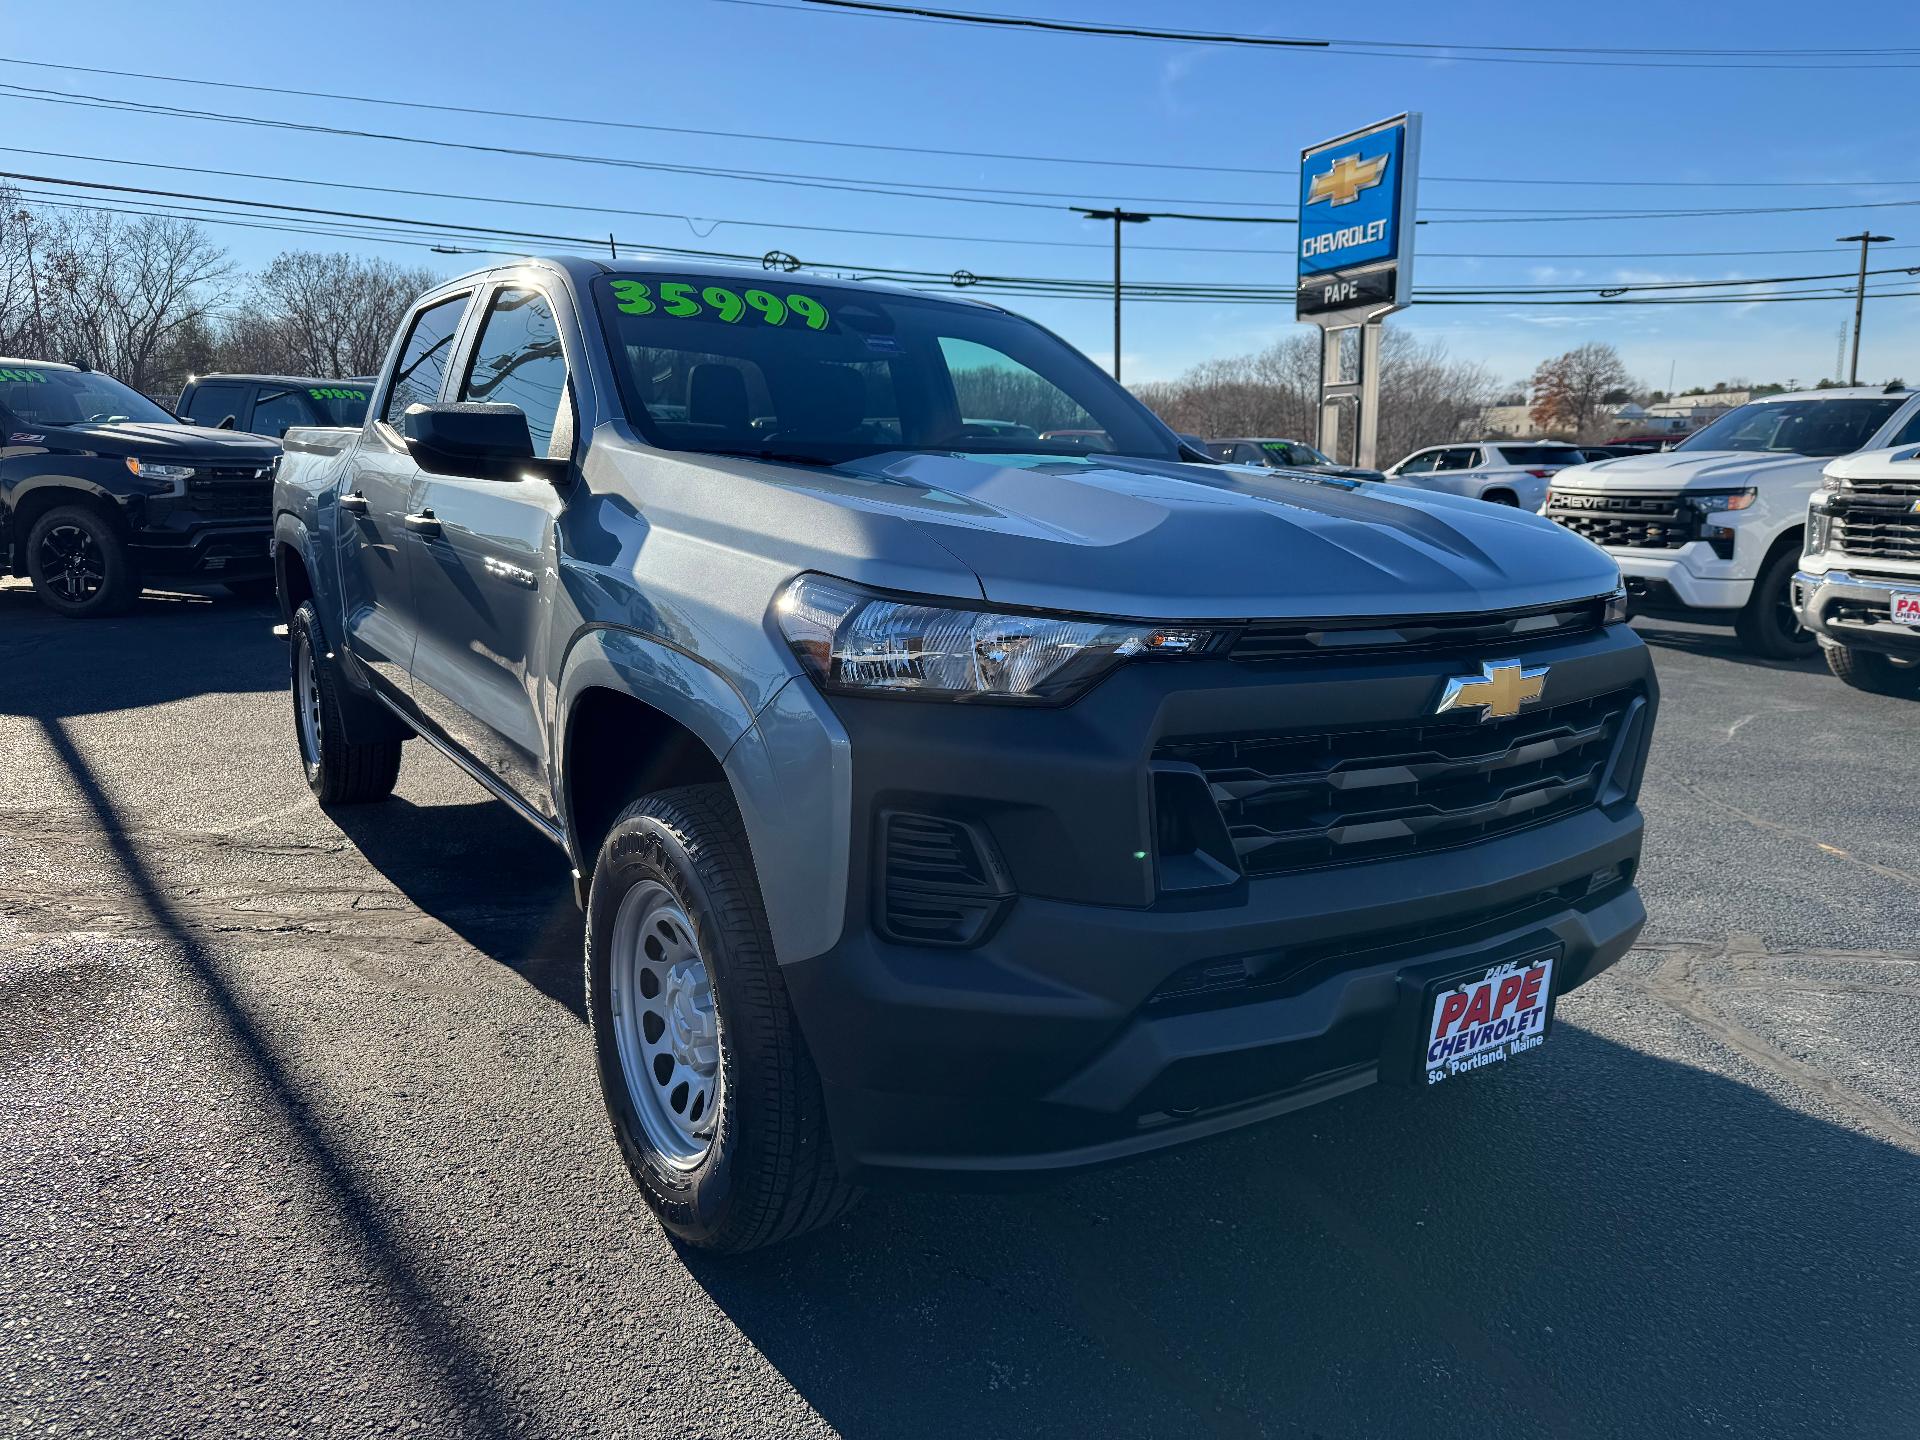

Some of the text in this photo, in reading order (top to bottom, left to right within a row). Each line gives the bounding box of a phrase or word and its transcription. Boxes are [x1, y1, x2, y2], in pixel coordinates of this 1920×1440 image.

[1302, 218, 1387, 258] CHEVROLET
[609, 279, 830, 331] 35999
[1324, 280, 1358, 304] PAPE
[1551, 494, 1673, 511] CHEVROLET
[1895, 611, 1920, 619] CHEV
[1485, 961, 1518, 980] PAPE
[1435, 965, 1547, 1039] PAPE
[1428, 1006, 1544, 1062] CHEVROLET
[1428, 1070, 1447, 1085] So.
[1451, 1046, 1507, 1076] Portland,
[1511, 1034, 1544, 1055] Maine
